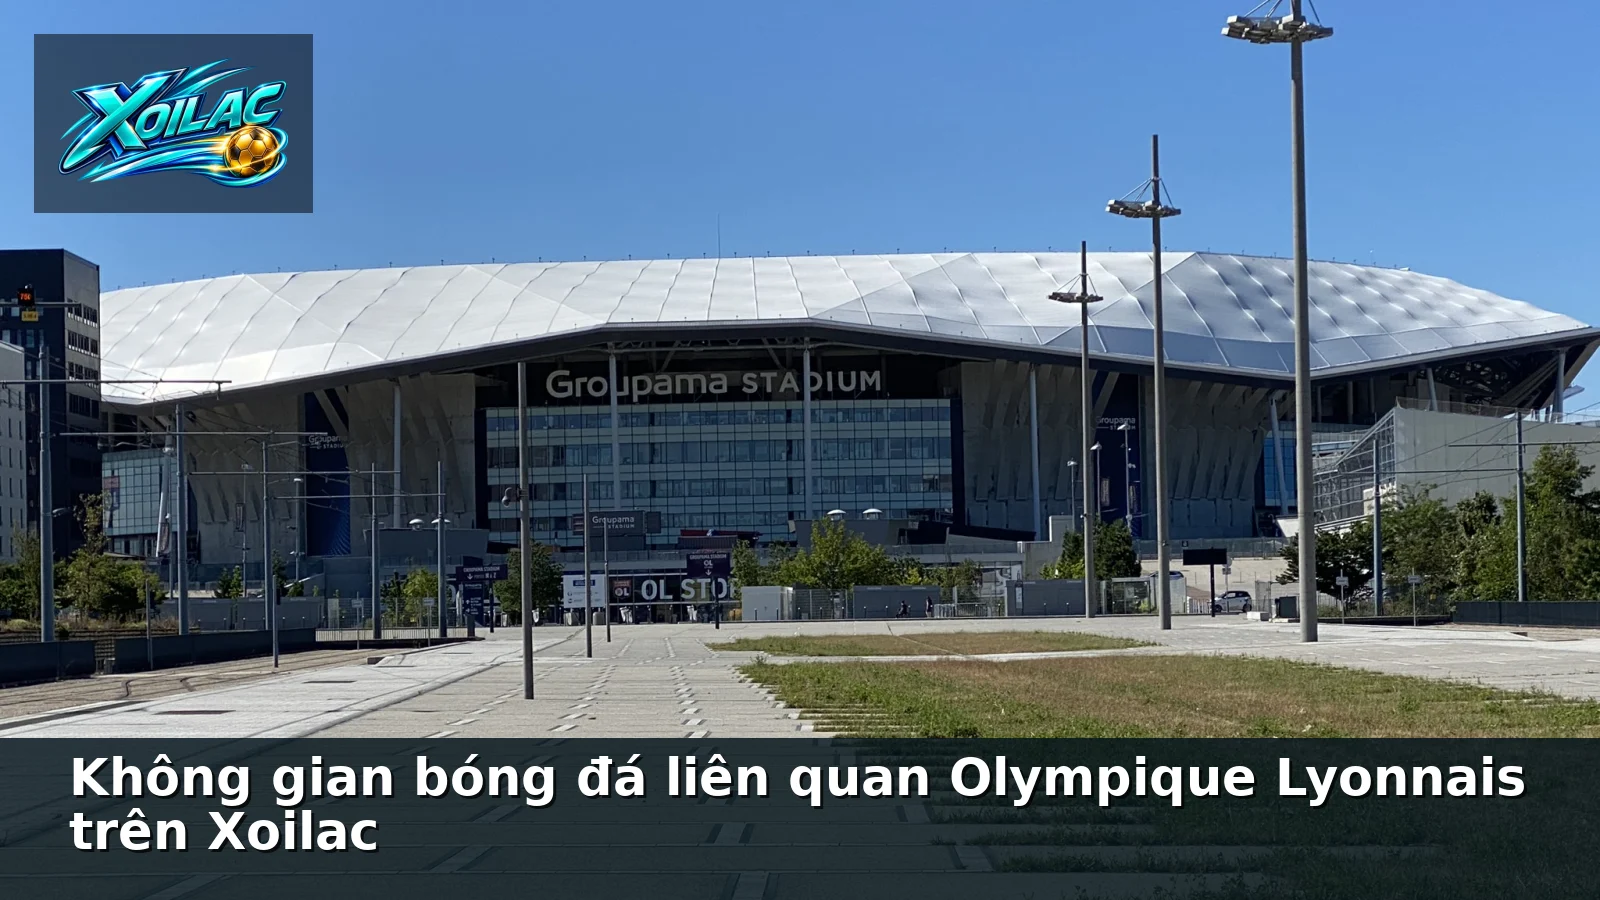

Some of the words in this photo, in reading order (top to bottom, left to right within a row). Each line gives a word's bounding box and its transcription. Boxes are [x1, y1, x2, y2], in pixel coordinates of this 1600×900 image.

[546, 369, 728, 402] Groupama
[742, 370, 882, 394] STADIUM
[592, 516, 635, 526] Groupama
[614, 587, 630, 597] OL
[641, 579, 673, 601] OL
